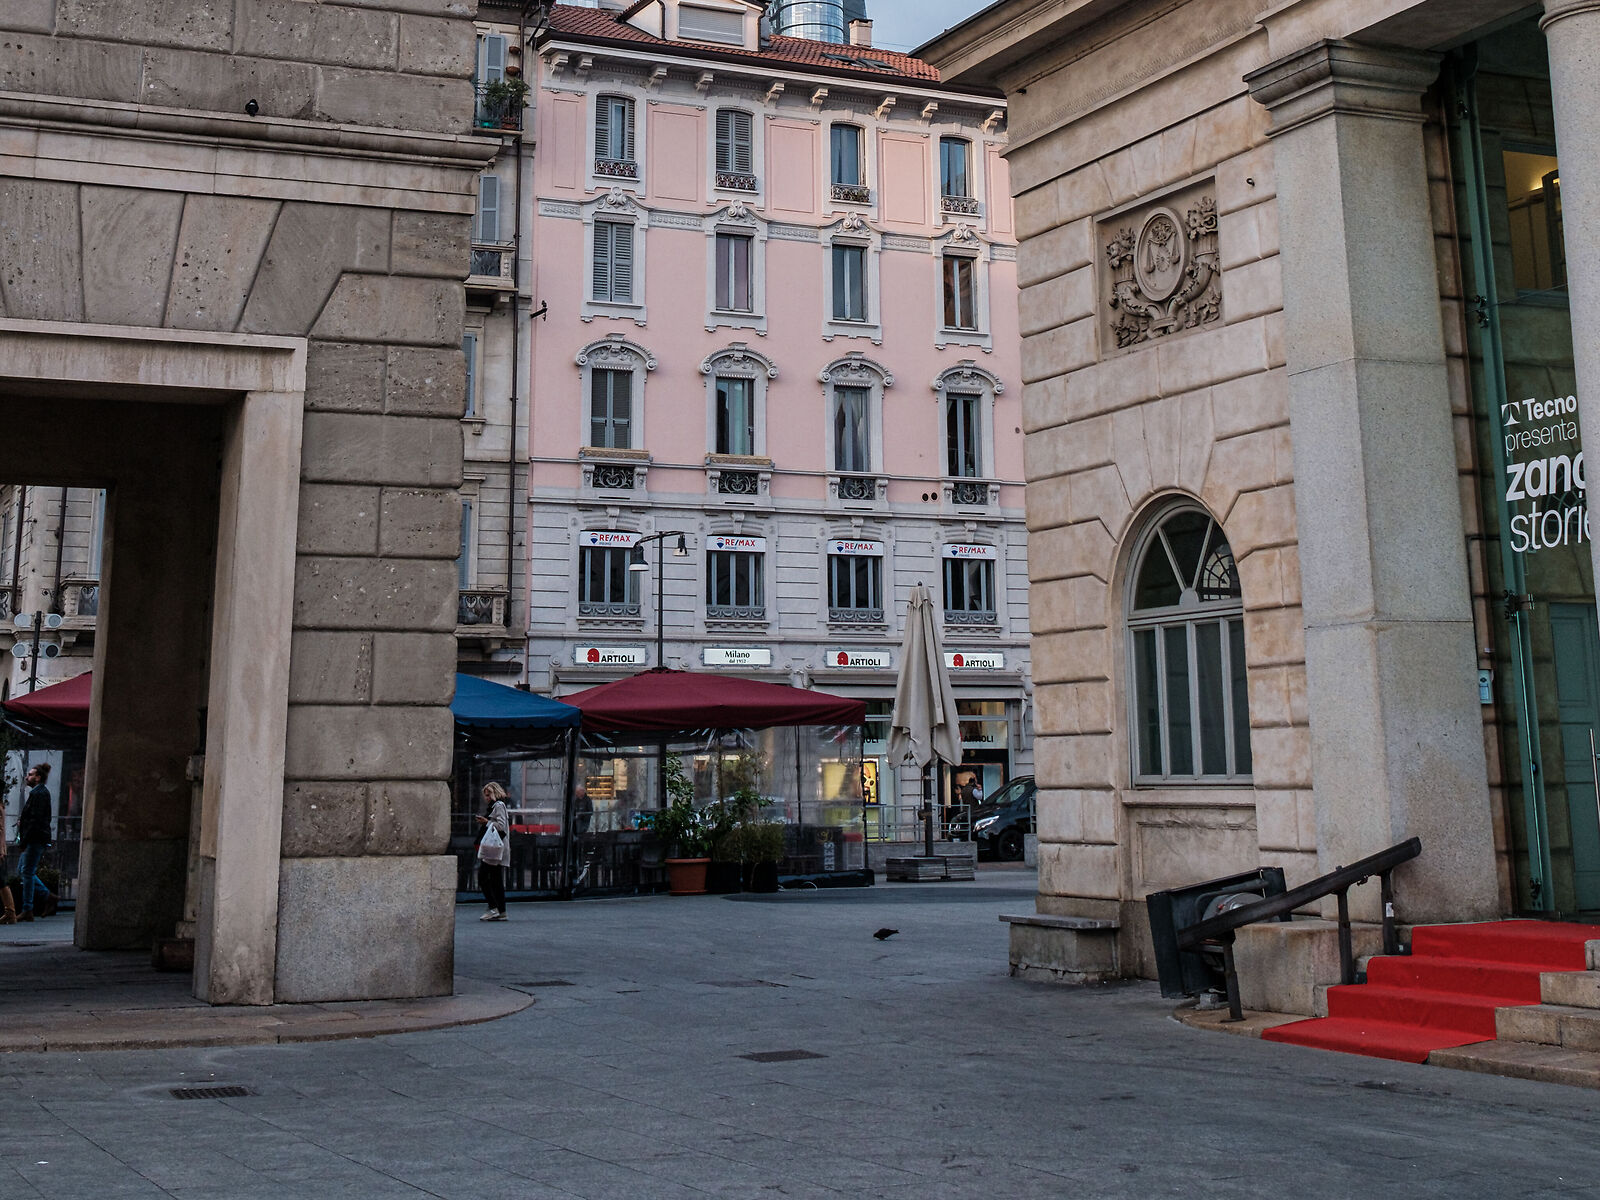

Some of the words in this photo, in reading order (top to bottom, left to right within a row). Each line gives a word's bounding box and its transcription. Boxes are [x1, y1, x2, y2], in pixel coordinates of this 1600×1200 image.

[1522, 395, 1577, 421] Tecno
[1505, 419, 1577, 457] presenta
[599, 534, 631, 542] RE/MAX
[725, 538, 755, 547] RE/MAX
[844, 542, 874, 551] RE/MAX
[959, 546, 986, 554] RE/MAX
[601, 654, 635, 663] ARTIOLI
[724, 650, 751, 658] Milano
[849, 658, 881, 666] ARTIOLI
[965, 659, 995, 668] ARTIOLI
